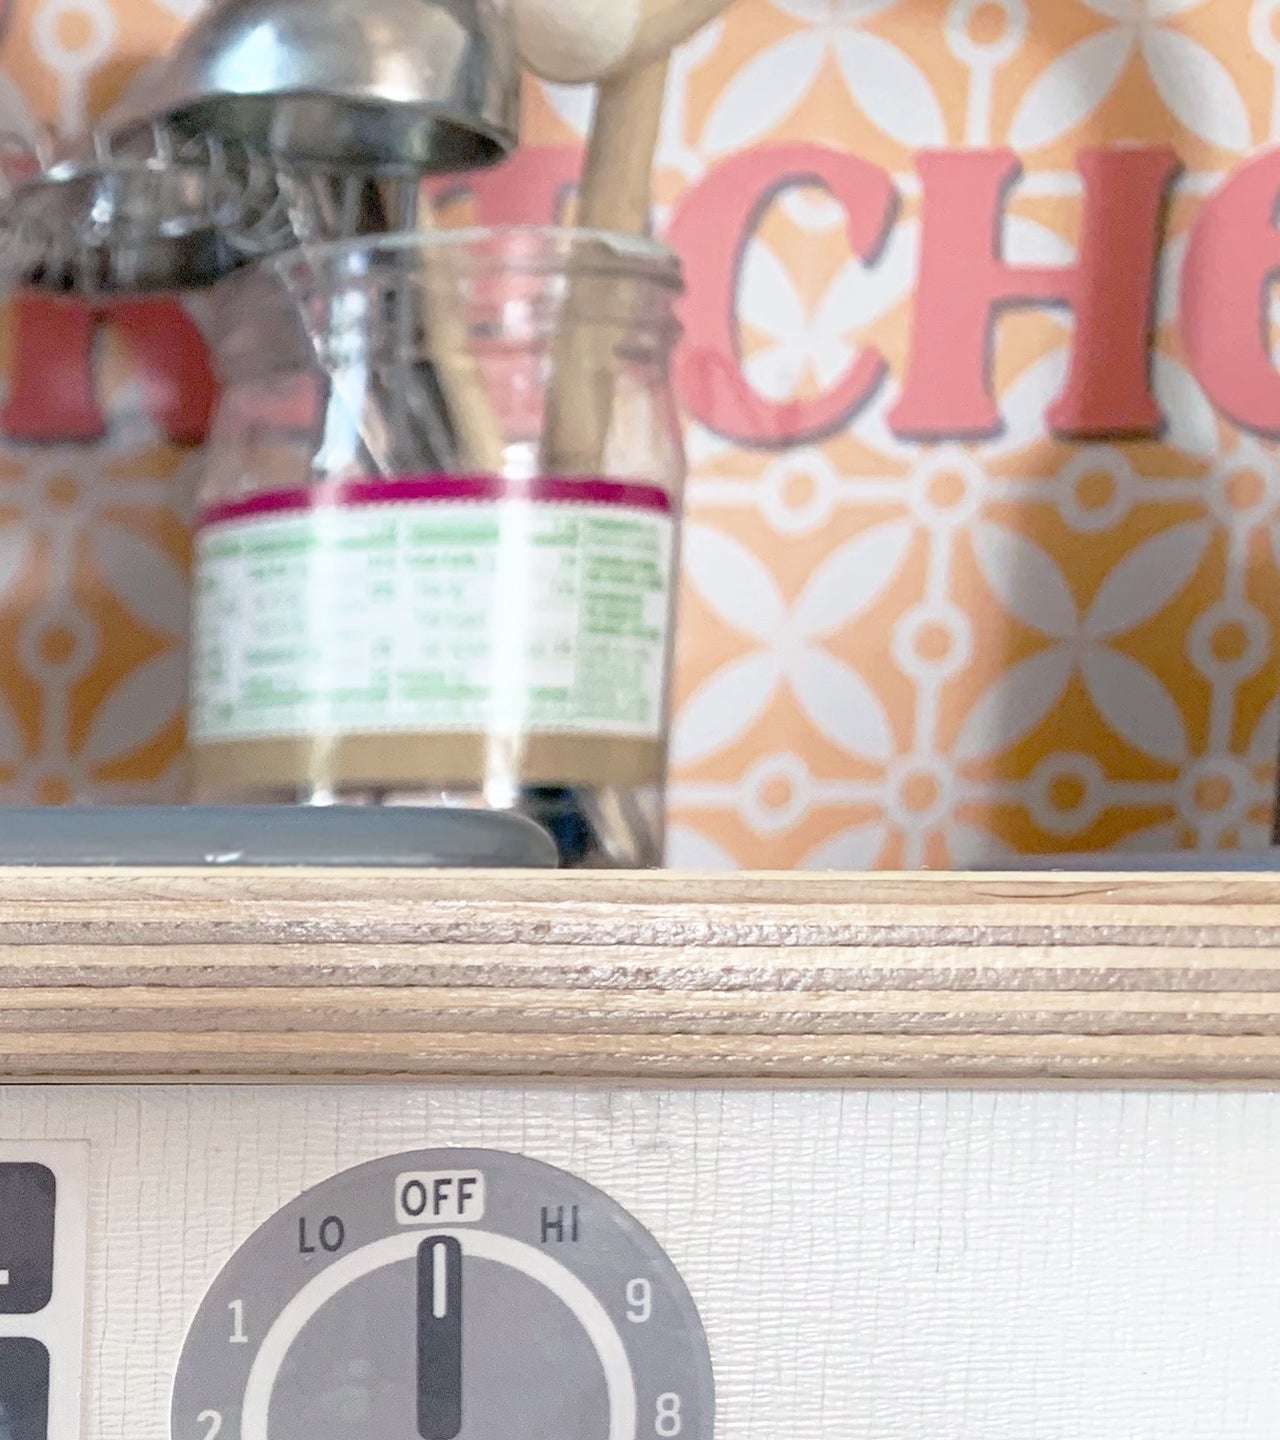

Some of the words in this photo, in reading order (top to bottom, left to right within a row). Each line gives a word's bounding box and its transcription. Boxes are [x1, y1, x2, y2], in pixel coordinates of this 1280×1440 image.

[400, 1177, 478, 1216] OFF
[298, 1215, 345, 1253] LO
[540, 1204, 579, 1244] HI
[227, 1299, 249, 1343] 1
[625, 1278, 652, 1323] 9
[654, 1392, 682, 1437] 8
